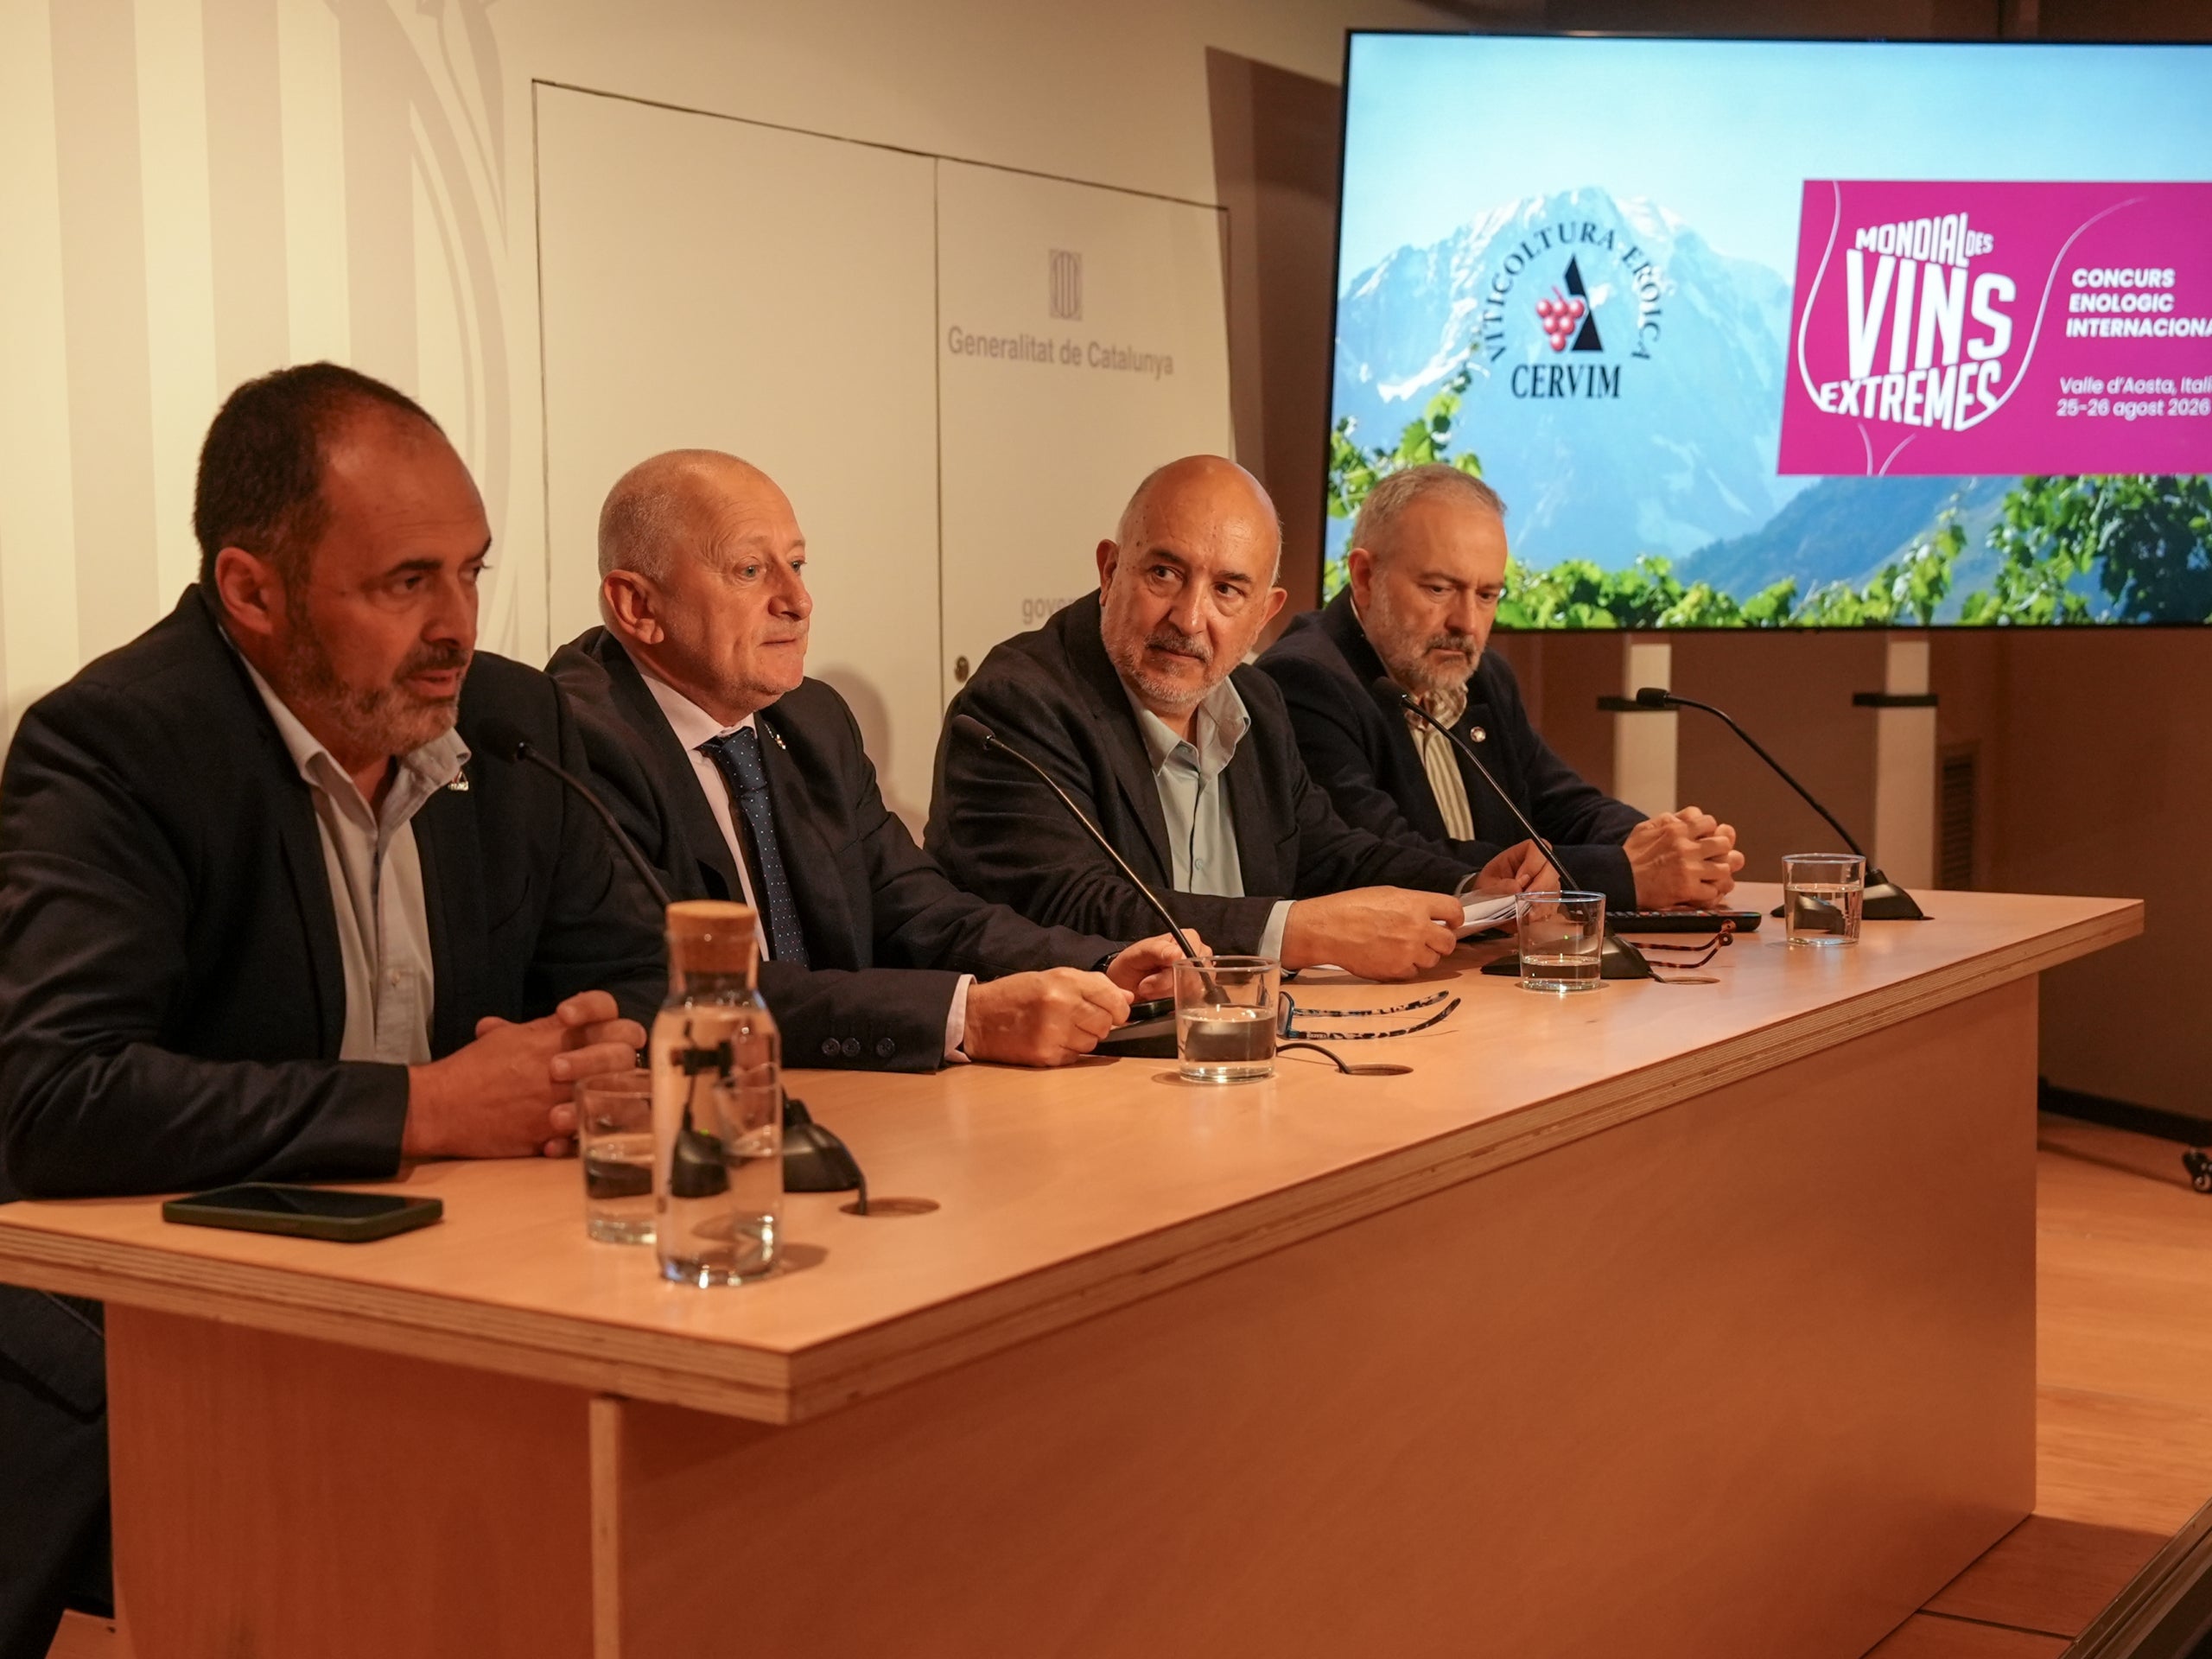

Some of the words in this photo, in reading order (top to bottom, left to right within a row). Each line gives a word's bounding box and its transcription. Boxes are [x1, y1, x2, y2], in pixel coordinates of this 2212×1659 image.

[1856, 212, 1969, 267] MONDIAL
[1965, 229, 1993, 257] DES
[1484, 221, 1614, 362] VITICOLTURA
[1622, 245, 1662, 361] EROICA
[2071, 268, 2176, 289] CONCURS
[1846, 248, 2016, 381] VINS
[2069, 292, 2175, 314] ENOLOGIC
[949, 325, 1054, 363] Generalitat
[1059, 340, 1082, 365] de
[1088, 341, 1173, 380] Catalunya
[1511, 364, 1621, 398] CERVIM
[1819, 359, 2001, 432] EXTREMES
[2059, 375, 2105, 395] Valle
[2056, 397, 2110, 416] 25-26
[2113, 398, 2165, 422] agost
[2167, 397, 2211, 416] 2026
